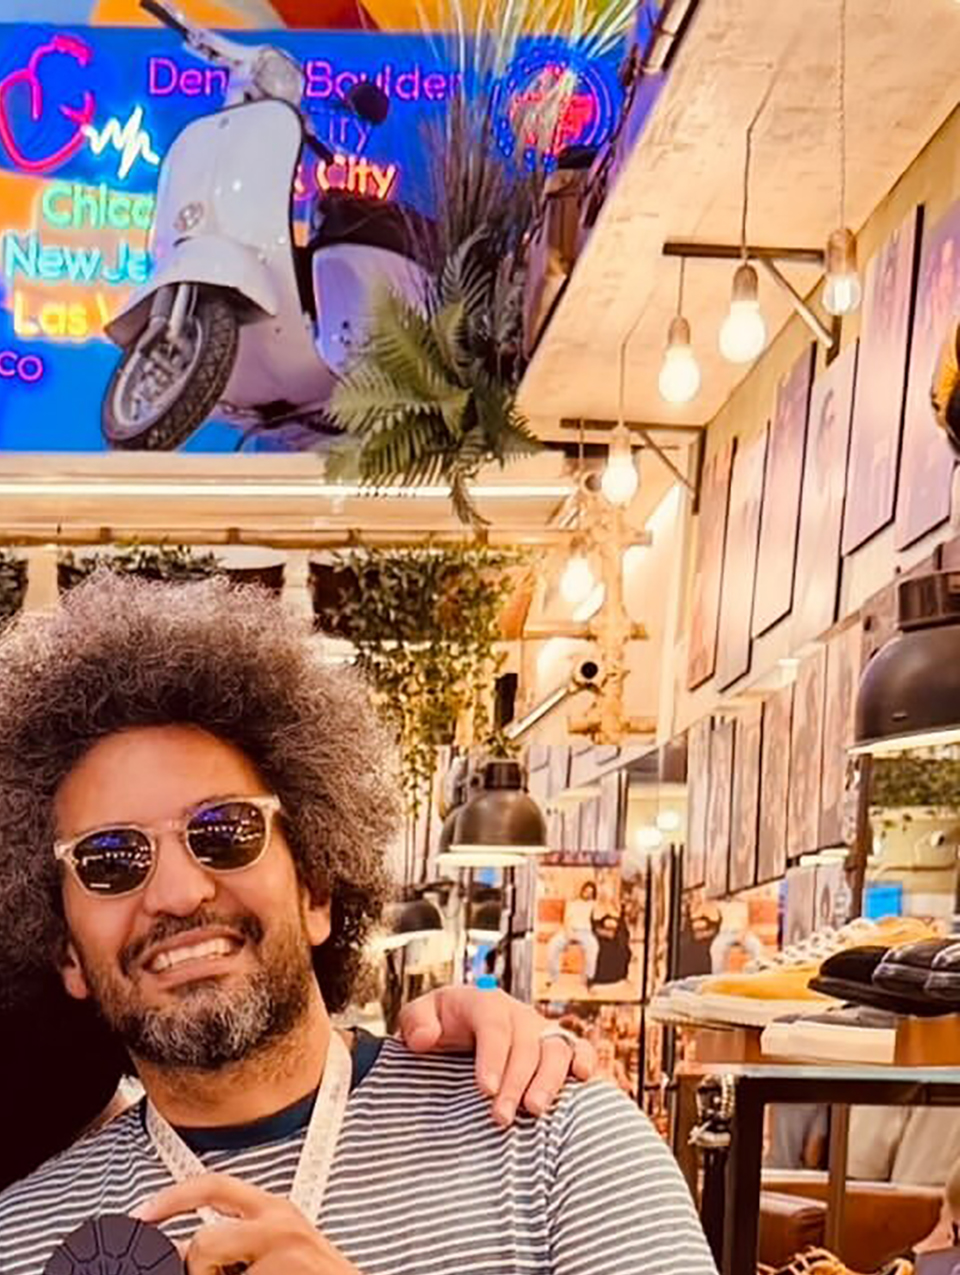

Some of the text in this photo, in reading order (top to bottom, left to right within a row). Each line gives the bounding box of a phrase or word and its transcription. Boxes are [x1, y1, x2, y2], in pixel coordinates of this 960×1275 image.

[149, 58, 227, 95] Den
[42, 182, 156, 229] Chica
[3, 230, 99, 282] New
[14, 290, 88, 337] Las
